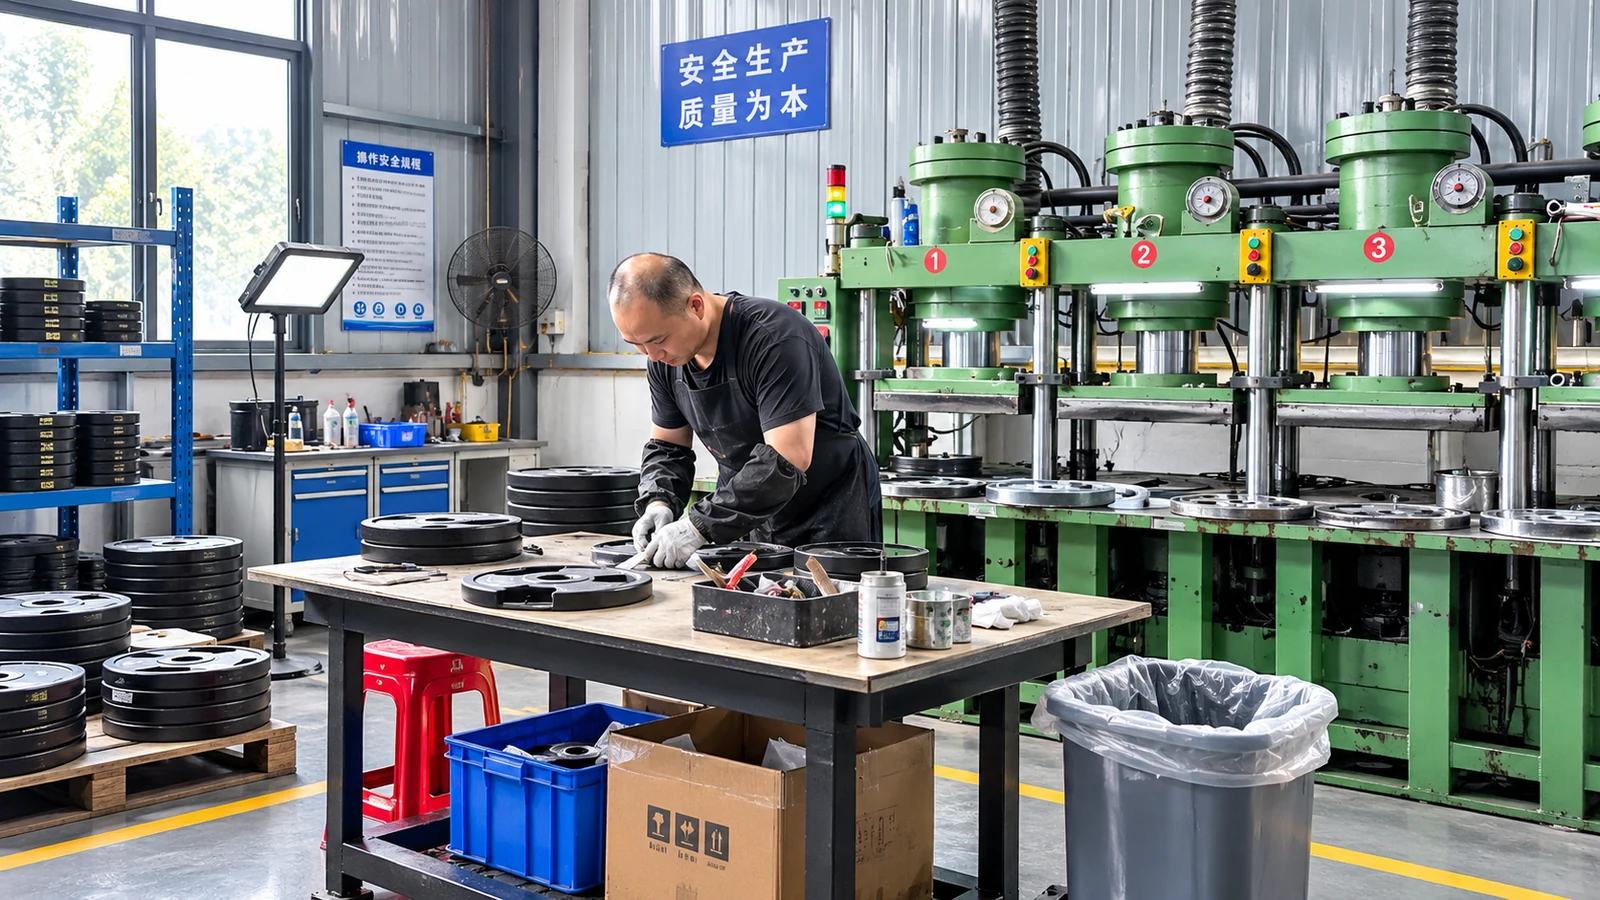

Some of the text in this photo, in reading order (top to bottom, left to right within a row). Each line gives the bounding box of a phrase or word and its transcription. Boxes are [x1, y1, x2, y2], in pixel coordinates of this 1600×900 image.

[679, 37, 808, 87] 安全生产
[678, 83, 808, 130] 质量为本
[1138, 245, 1150, 264] 2
[1371, 237, 1386, 258] 3
[931, 251, 938, 270] 1
